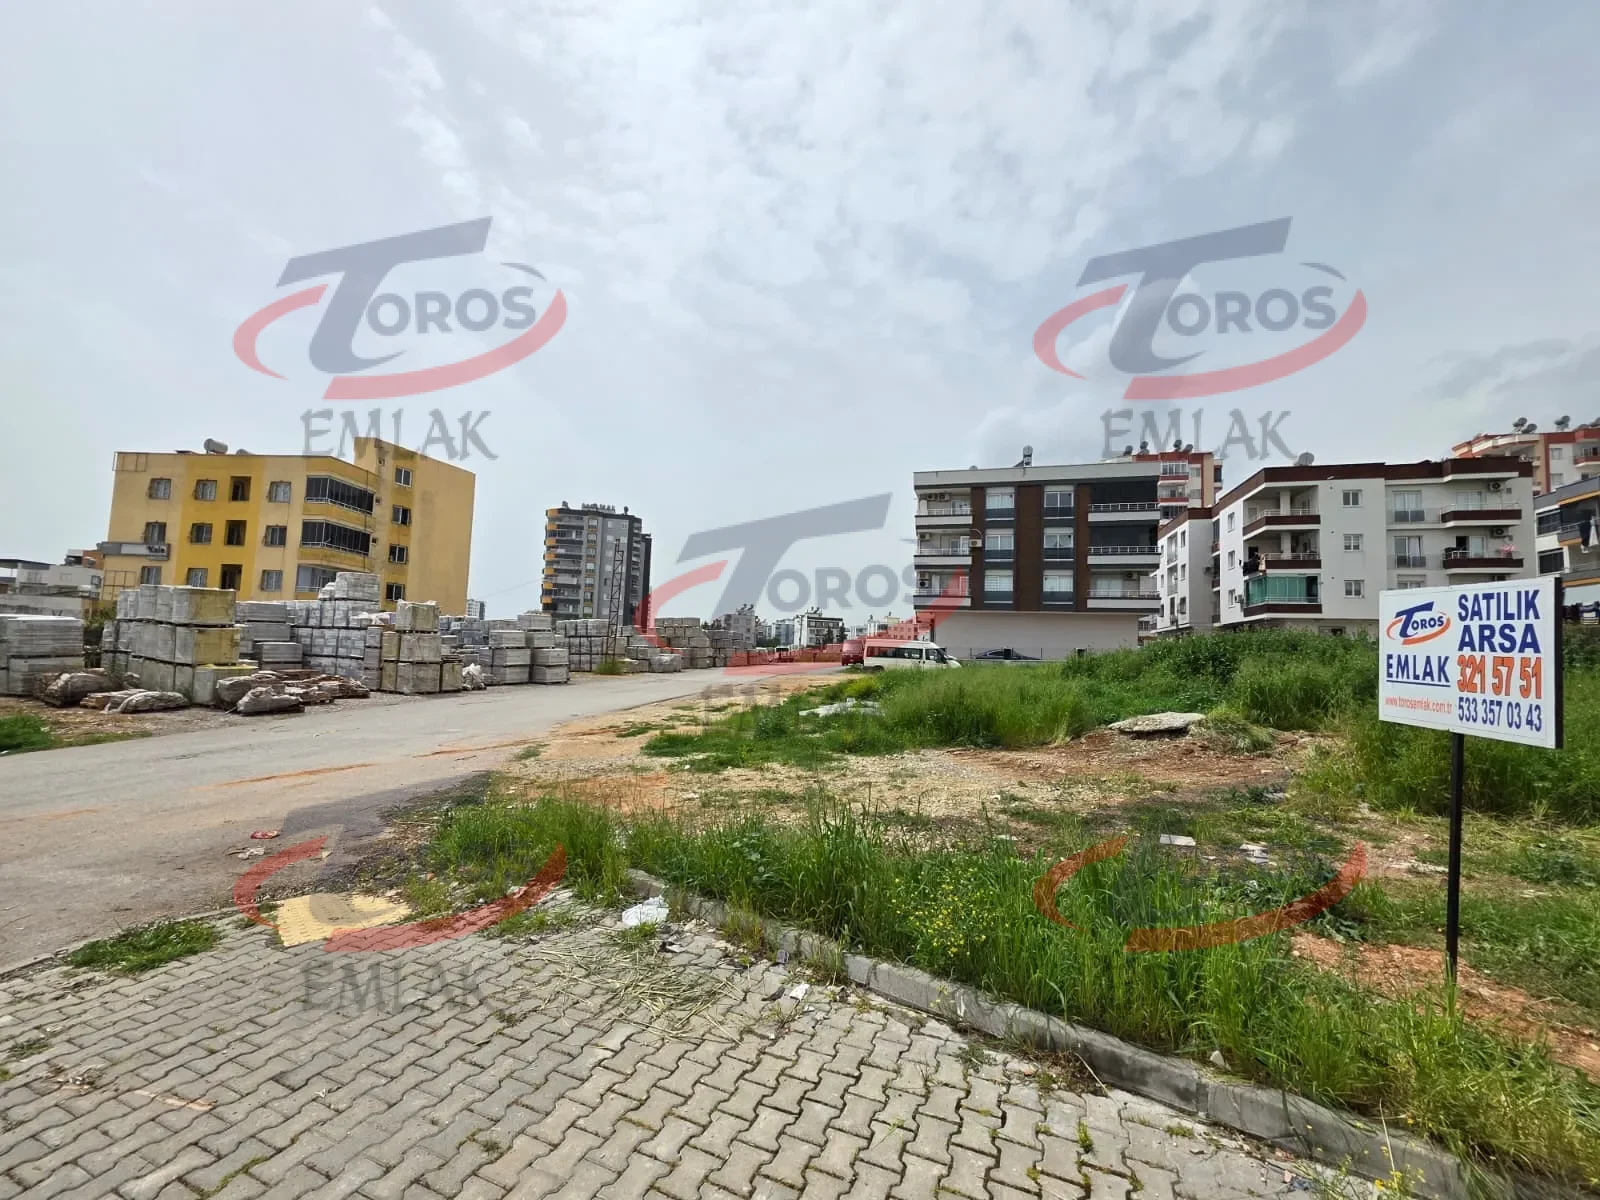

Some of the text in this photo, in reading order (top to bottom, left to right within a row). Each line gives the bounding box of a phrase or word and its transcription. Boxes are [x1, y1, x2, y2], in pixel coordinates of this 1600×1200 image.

[1394, 601, 1445, 639] TOROS
[1458, 589, 1540, 622] SATILIK
[1458, 623, 1541, 653] ARSA
[1386, 653, 1450, 683] EMLAK
[1457, 655, 1542, 699] 321 57 51
[1458, 696, 1542, 732] 533 357 03 43
